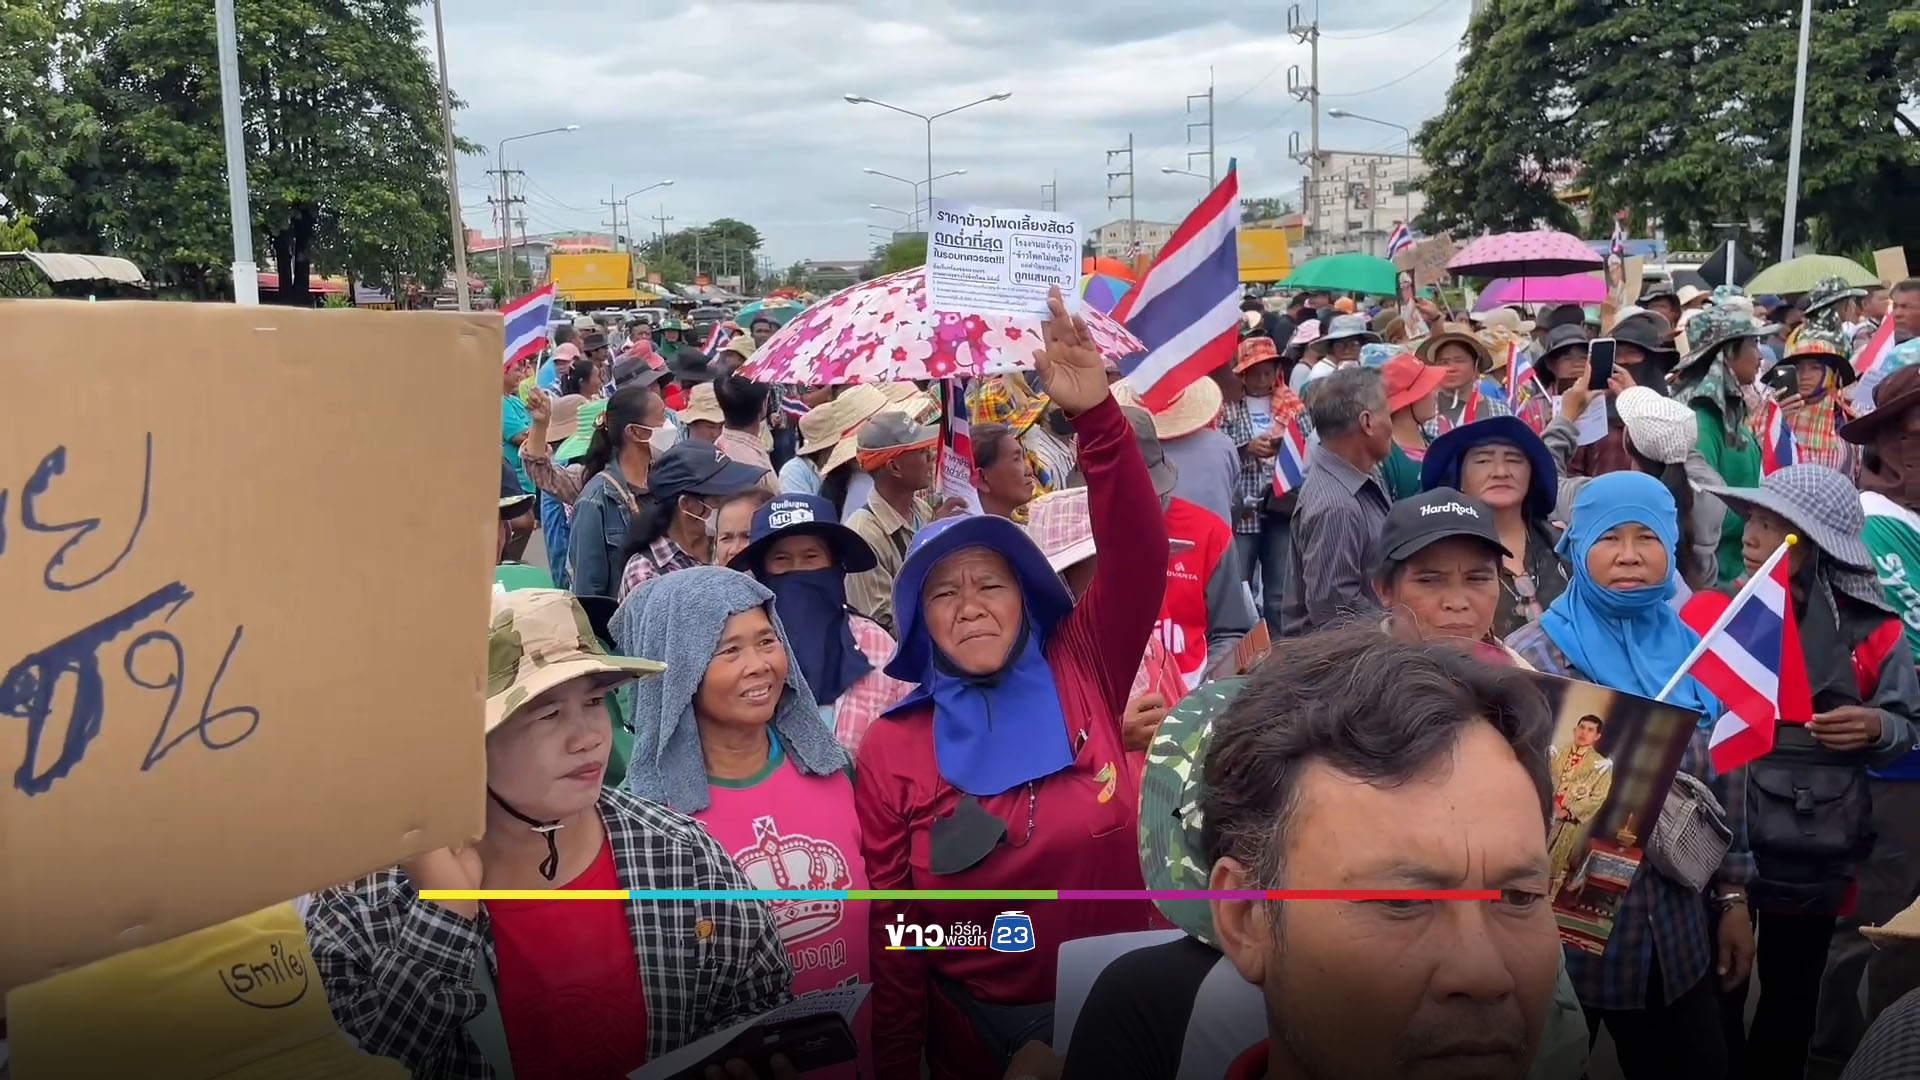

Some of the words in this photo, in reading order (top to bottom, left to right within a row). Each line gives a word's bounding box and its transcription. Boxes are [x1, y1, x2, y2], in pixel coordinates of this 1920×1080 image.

[937, 209, 1075, 234] ราคาข้าวโพดเลี้ยงสัตว์
[934, 228, 1004, 252] ตกต่ำที่สุด
[772, 513, 790, 526] MC
[1419, 501, 1450, 517] Hard
[1450, 501, 1479, 518] Rock
[231, 940, 304, 993] smile
